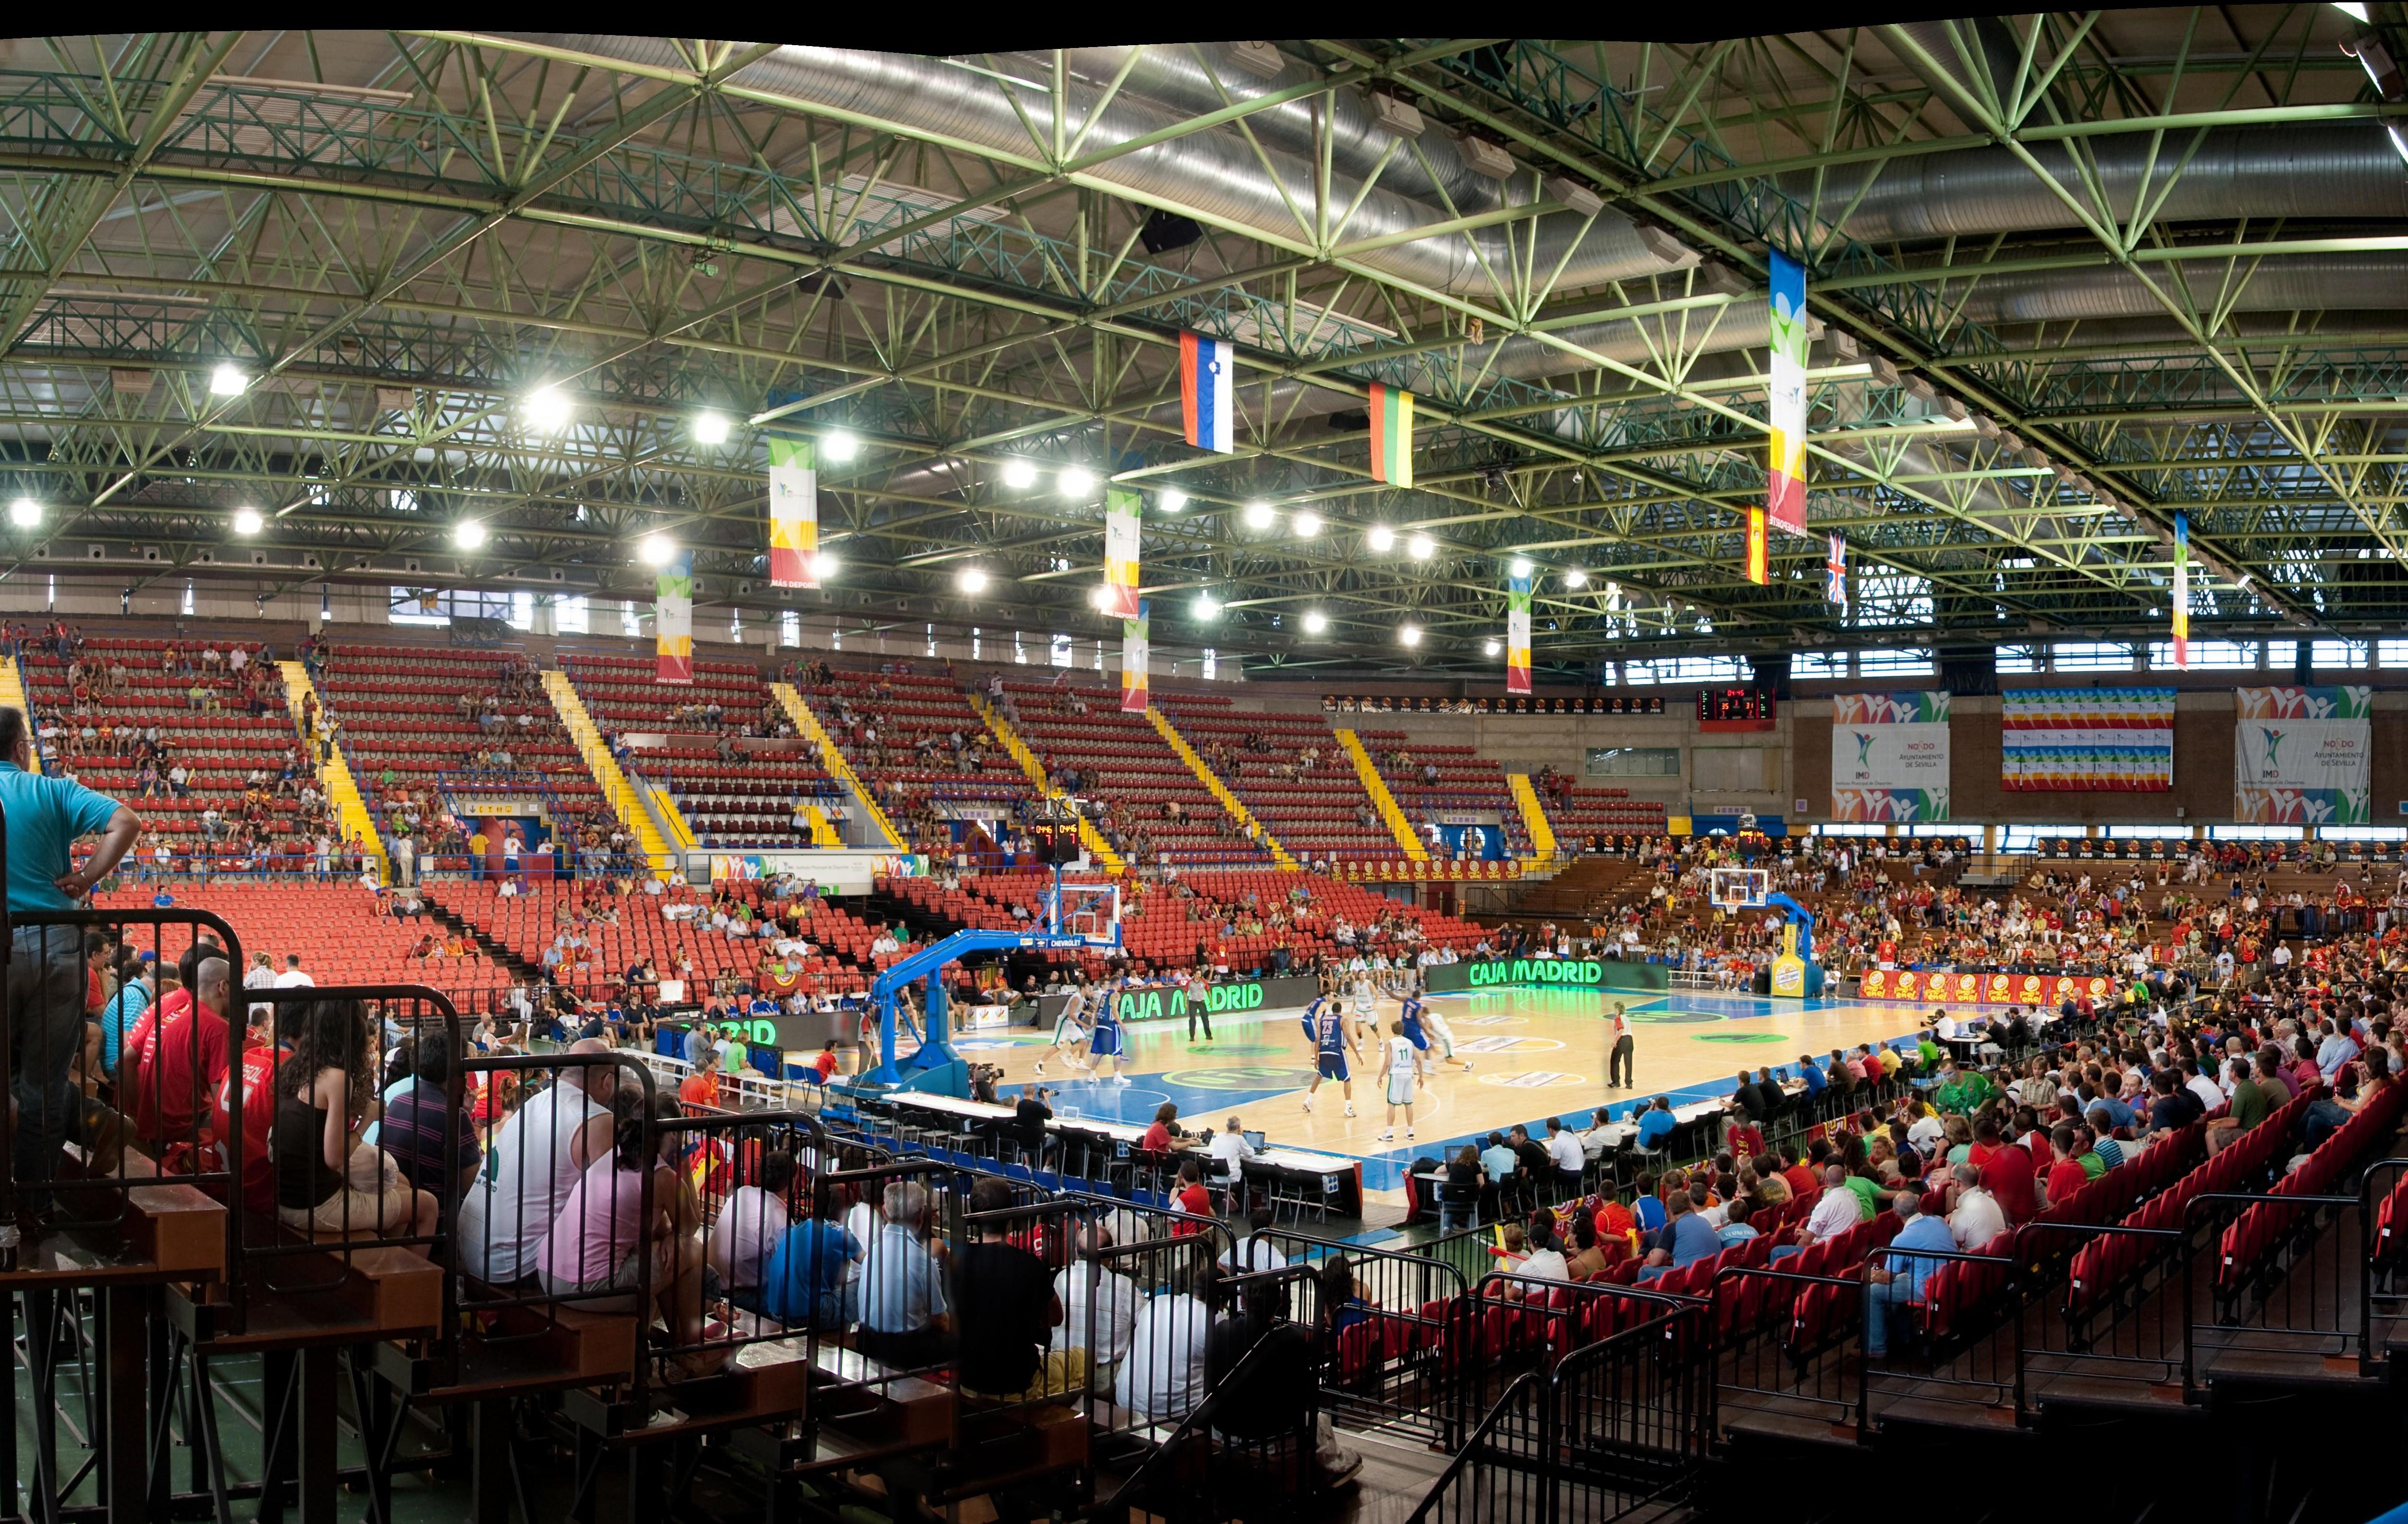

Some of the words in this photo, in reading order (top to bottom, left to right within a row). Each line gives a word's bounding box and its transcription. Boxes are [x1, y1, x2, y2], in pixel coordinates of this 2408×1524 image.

[771, 579, 787, 587] MÁS
[1046, 835, 1051, 845] 7
[1070, 834, 1075, 844] 7
[1470, 962, 1507, 985] CAJA
[1512, 960, 1602, 983] MADRID
[1119, 991, 1163, 1020] AJA
[1322, 1021, 1333, 1034] 23
[1399, 1048, 1408, 1061] 11
